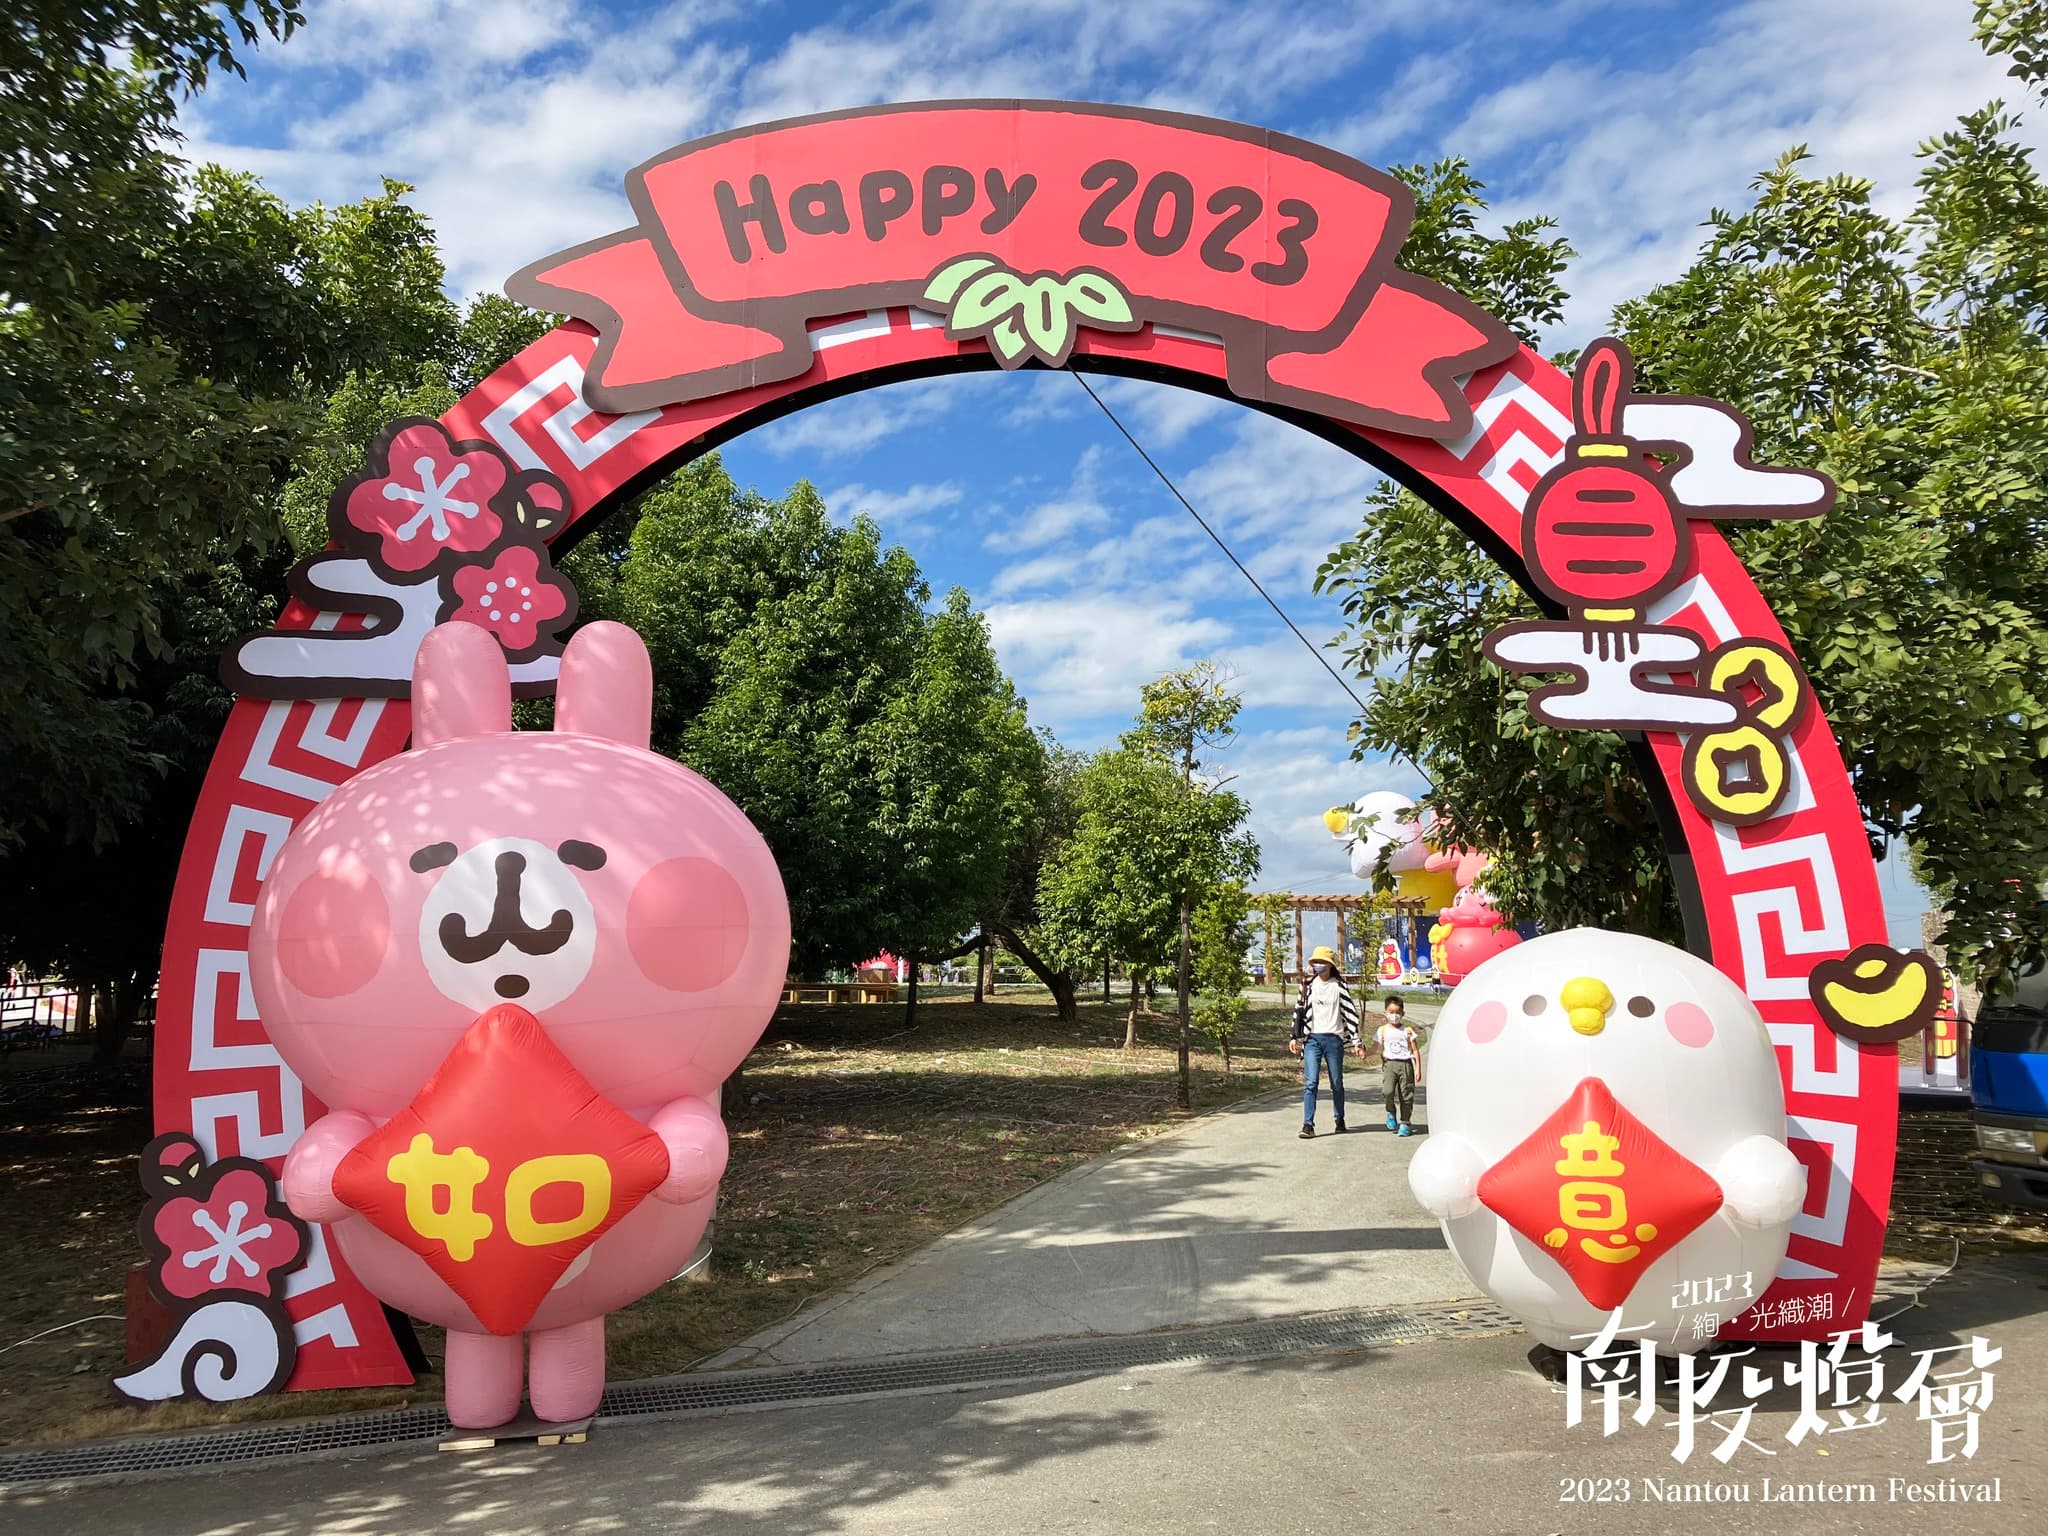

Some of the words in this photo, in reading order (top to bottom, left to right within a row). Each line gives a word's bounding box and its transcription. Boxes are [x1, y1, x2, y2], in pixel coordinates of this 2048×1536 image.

[713, 164, 1037, 264] Happy
[1078, 159, 1319, 286] 2023
[387, 1132, 612, 1262] 如
[1544, 1120, 1658, 1263] 意
